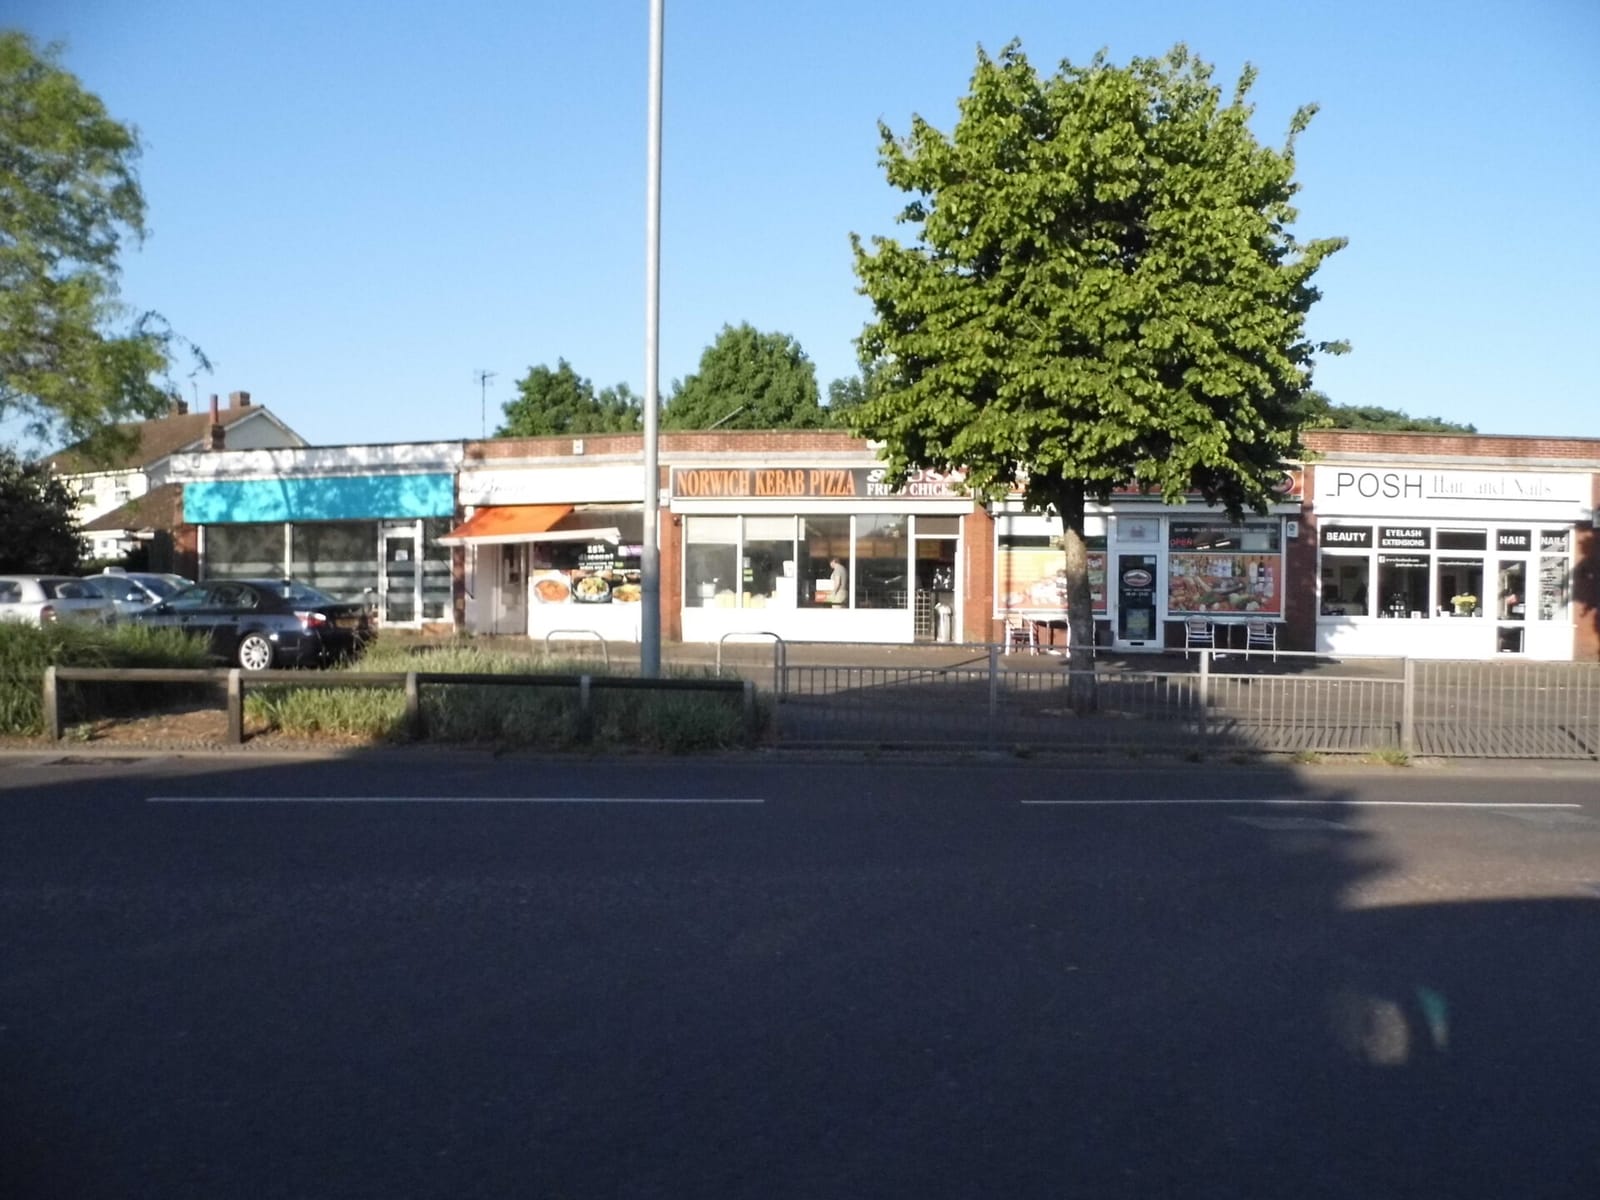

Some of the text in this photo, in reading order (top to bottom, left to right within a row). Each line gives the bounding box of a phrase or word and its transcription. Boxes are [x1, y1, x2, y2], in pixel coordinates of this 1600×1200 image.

[677, 470, 856, 496] NORWICH KEBAB PIZZA
[1337, 472, 1552, 498] POSH Hair and Nails
[867, 483, 907, 496] FRID
[1326, 532, 1366, 542] BEAUTY
[1385, 529, 1422, 538] EYELASH
[1382, 538, 1425, 547] EXTENSIONS
[1499, 536, 1526, 545] HAIR
